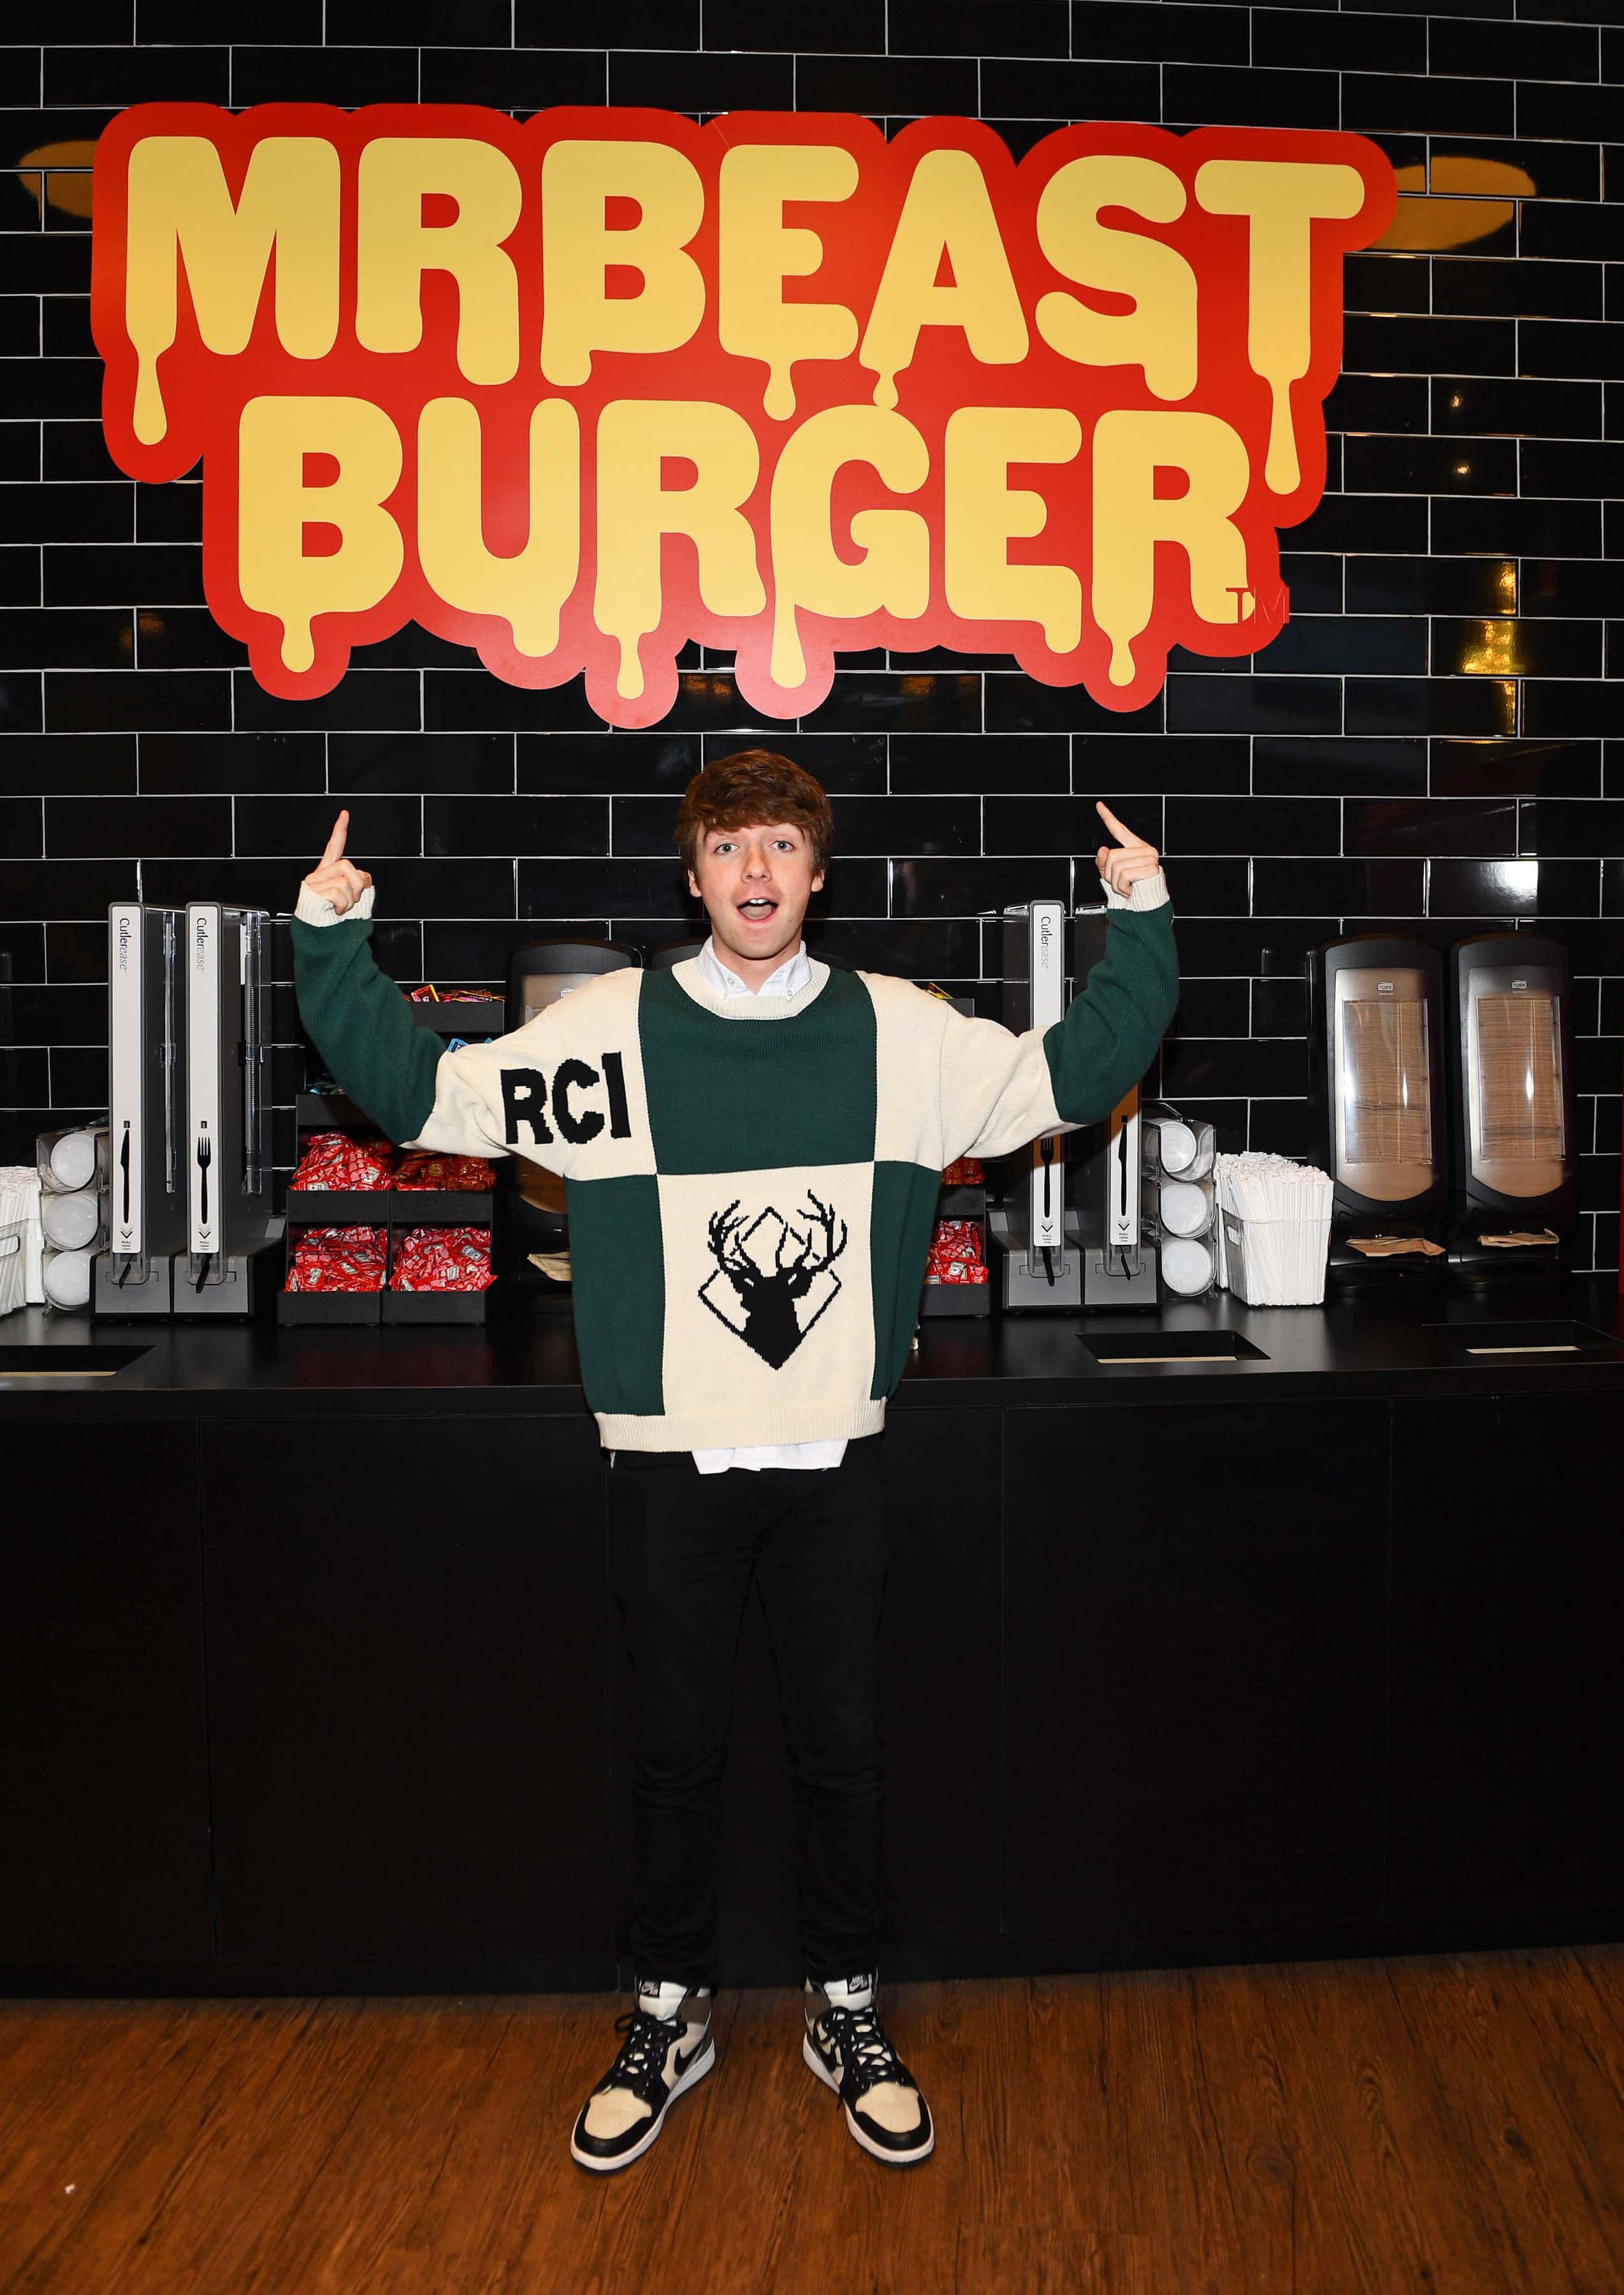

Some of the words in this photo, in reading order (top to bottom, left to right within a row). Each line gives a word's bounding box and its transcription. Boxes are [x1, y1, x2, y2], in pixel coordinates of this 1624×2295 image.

[127, 137, 1364, 494] MRBEAST
[239, 397, 1249, 698] BURGER
[500, 1051, 632, 1144] RCI
